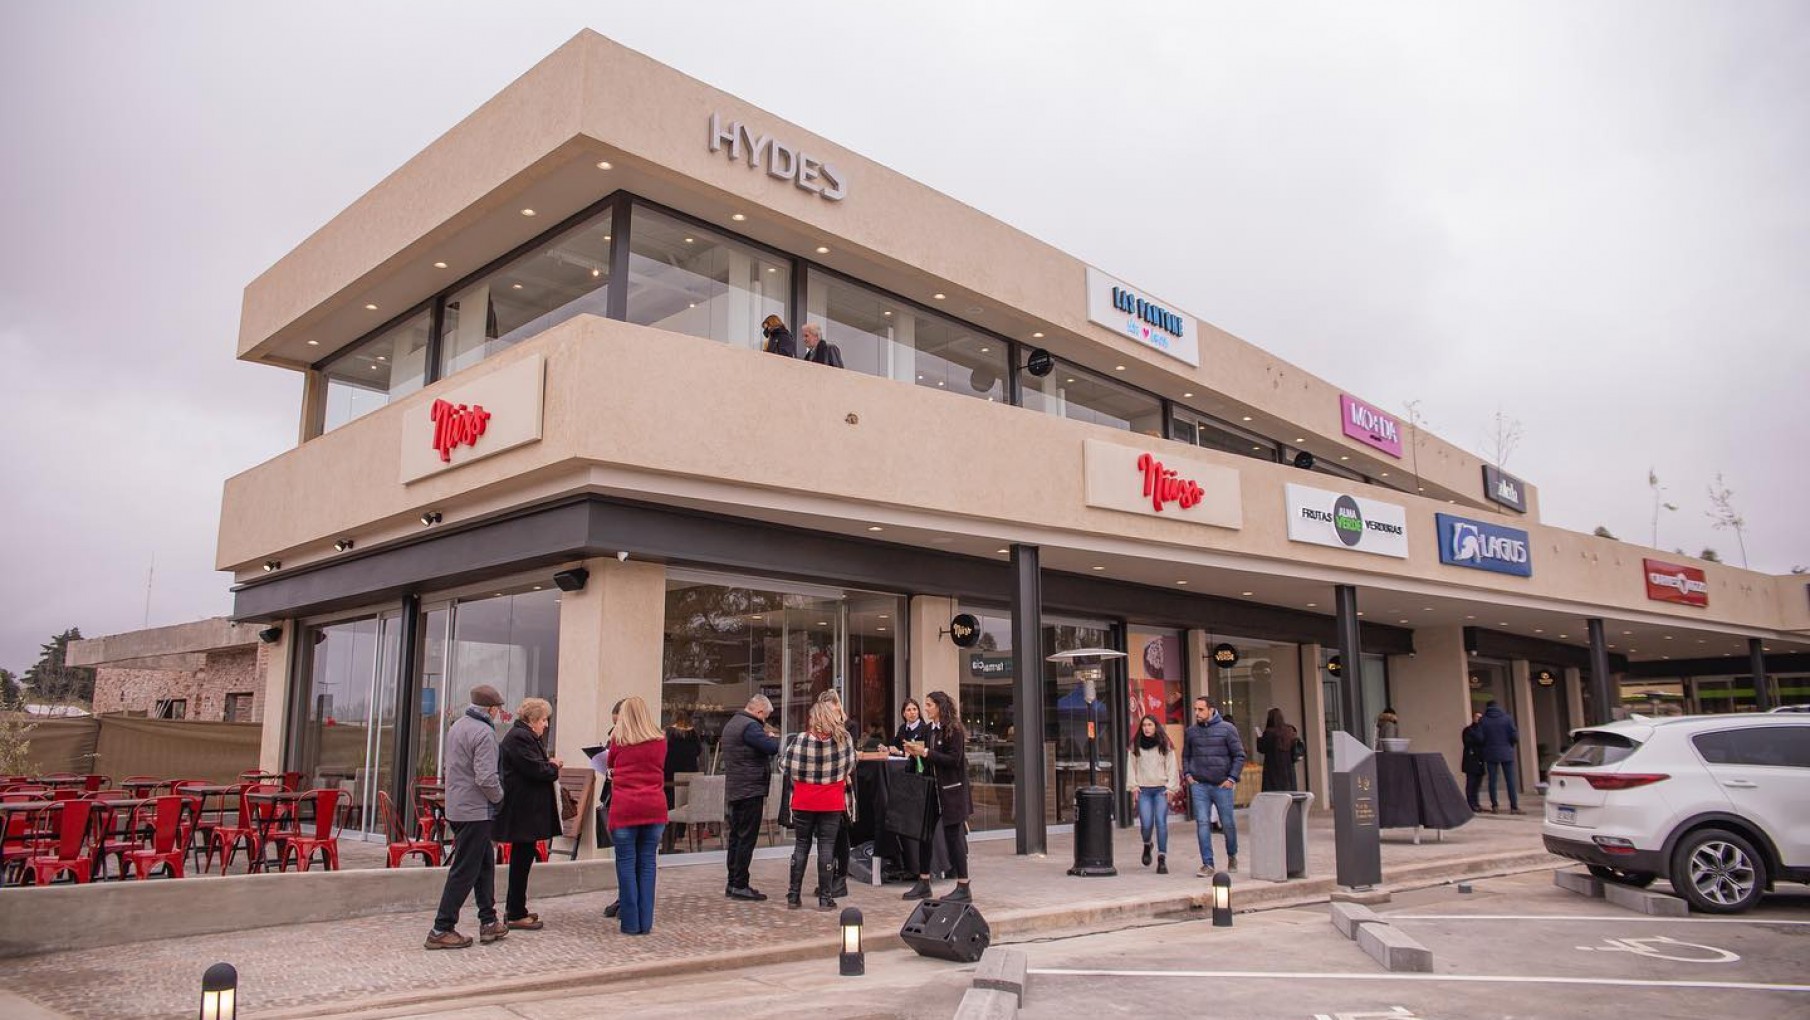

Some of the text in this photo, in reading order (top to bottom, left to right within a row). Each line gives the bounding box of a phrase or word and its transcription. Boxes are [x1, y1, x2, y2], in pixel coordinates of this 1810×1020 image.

[709, 109, 824, 194] HYDE
[1112, 286, 1136, 315] LAS
[1302, 507, 1404, 536] FRUTAS VERDURAS
